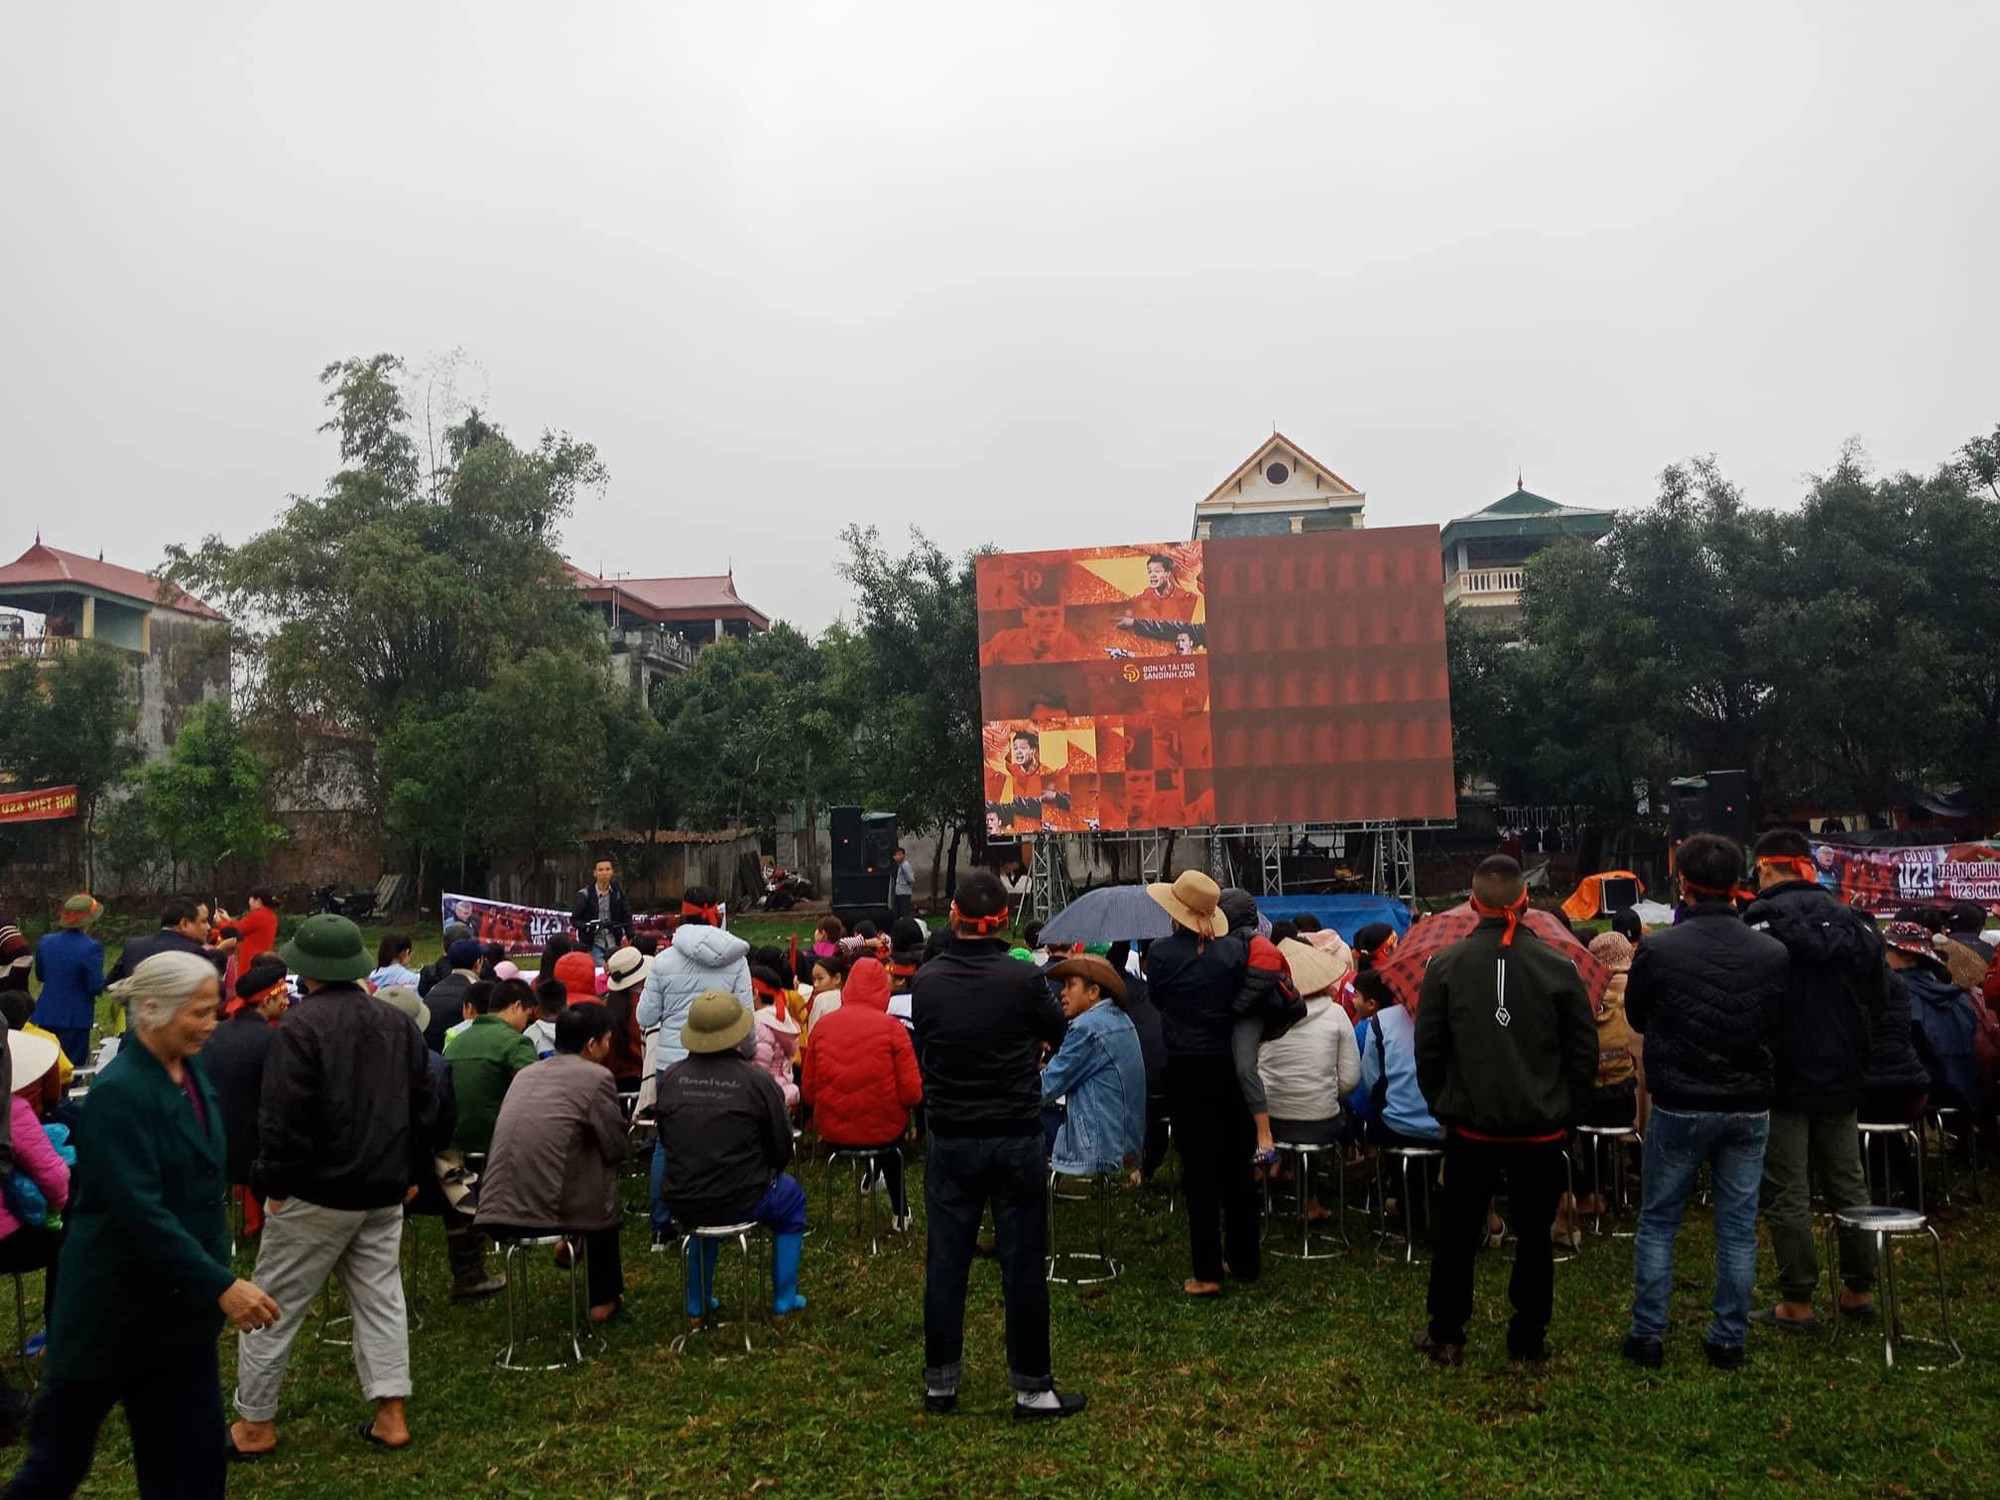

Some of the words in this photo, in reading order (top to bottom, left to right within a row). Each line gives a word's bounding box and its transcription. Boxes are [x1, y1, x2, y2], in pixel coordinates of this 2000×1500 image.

[1899, 862, 1934, 889] U23
[1950, 883, 1974, 899] U23
[1976, 881, 2000, 899] CHÂ
